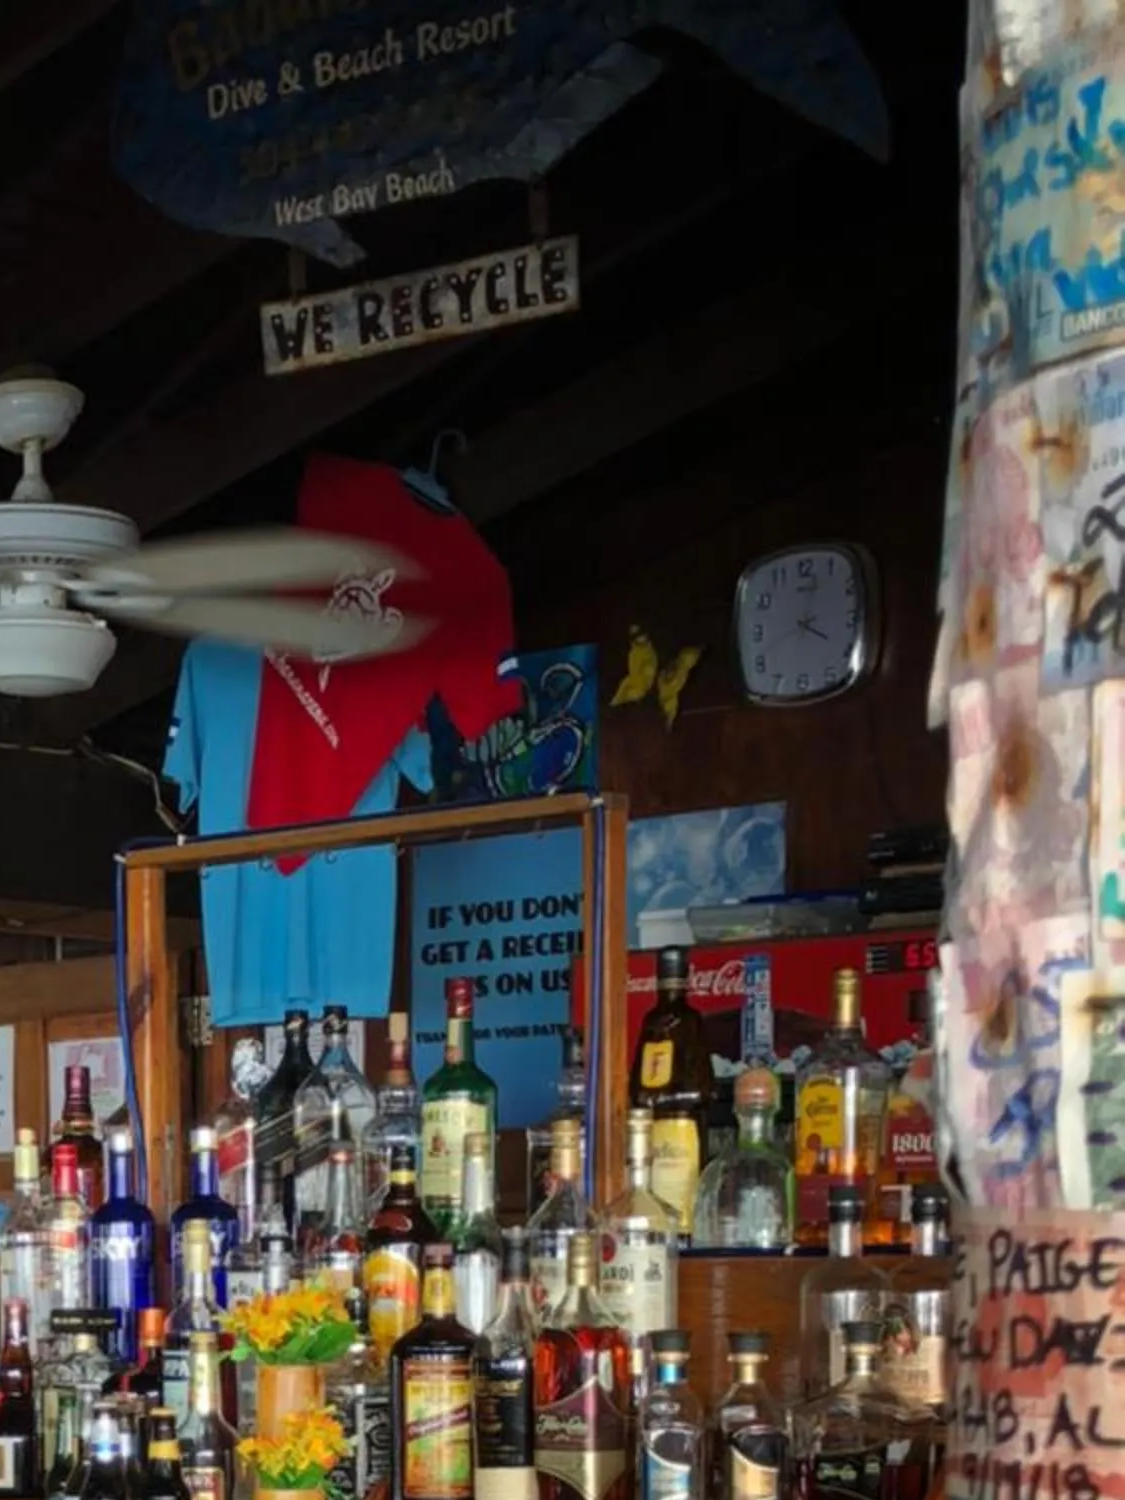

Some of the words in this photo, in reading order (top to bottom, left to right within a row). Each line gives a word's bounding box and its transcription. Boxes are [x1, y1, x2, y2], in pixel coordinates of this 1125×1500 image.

[207, 77, 268, 121] Dive
[277, 61, 305, 95] &
[313, 27, 404, 88] Beach
[416, 5, 518, 61] Resort
[275, 193, 325, 227] West
[332, 181, 378, 217] Bay
[386, 158, 456, 203] Beach
[270, 301, 334, 362] WE
[357, 248, 568, 346] RECYCLE
[797, 558, 814, 578] 12
[428, 906, 452, 929] IF
[459, 899, 514, 927] YOU
[421, 940, 470, 965] GET
[476, 938, 494, 961] A
[495, 971, 534, 995] ON
[988, 1229, 1125, 1301] PAIGE
